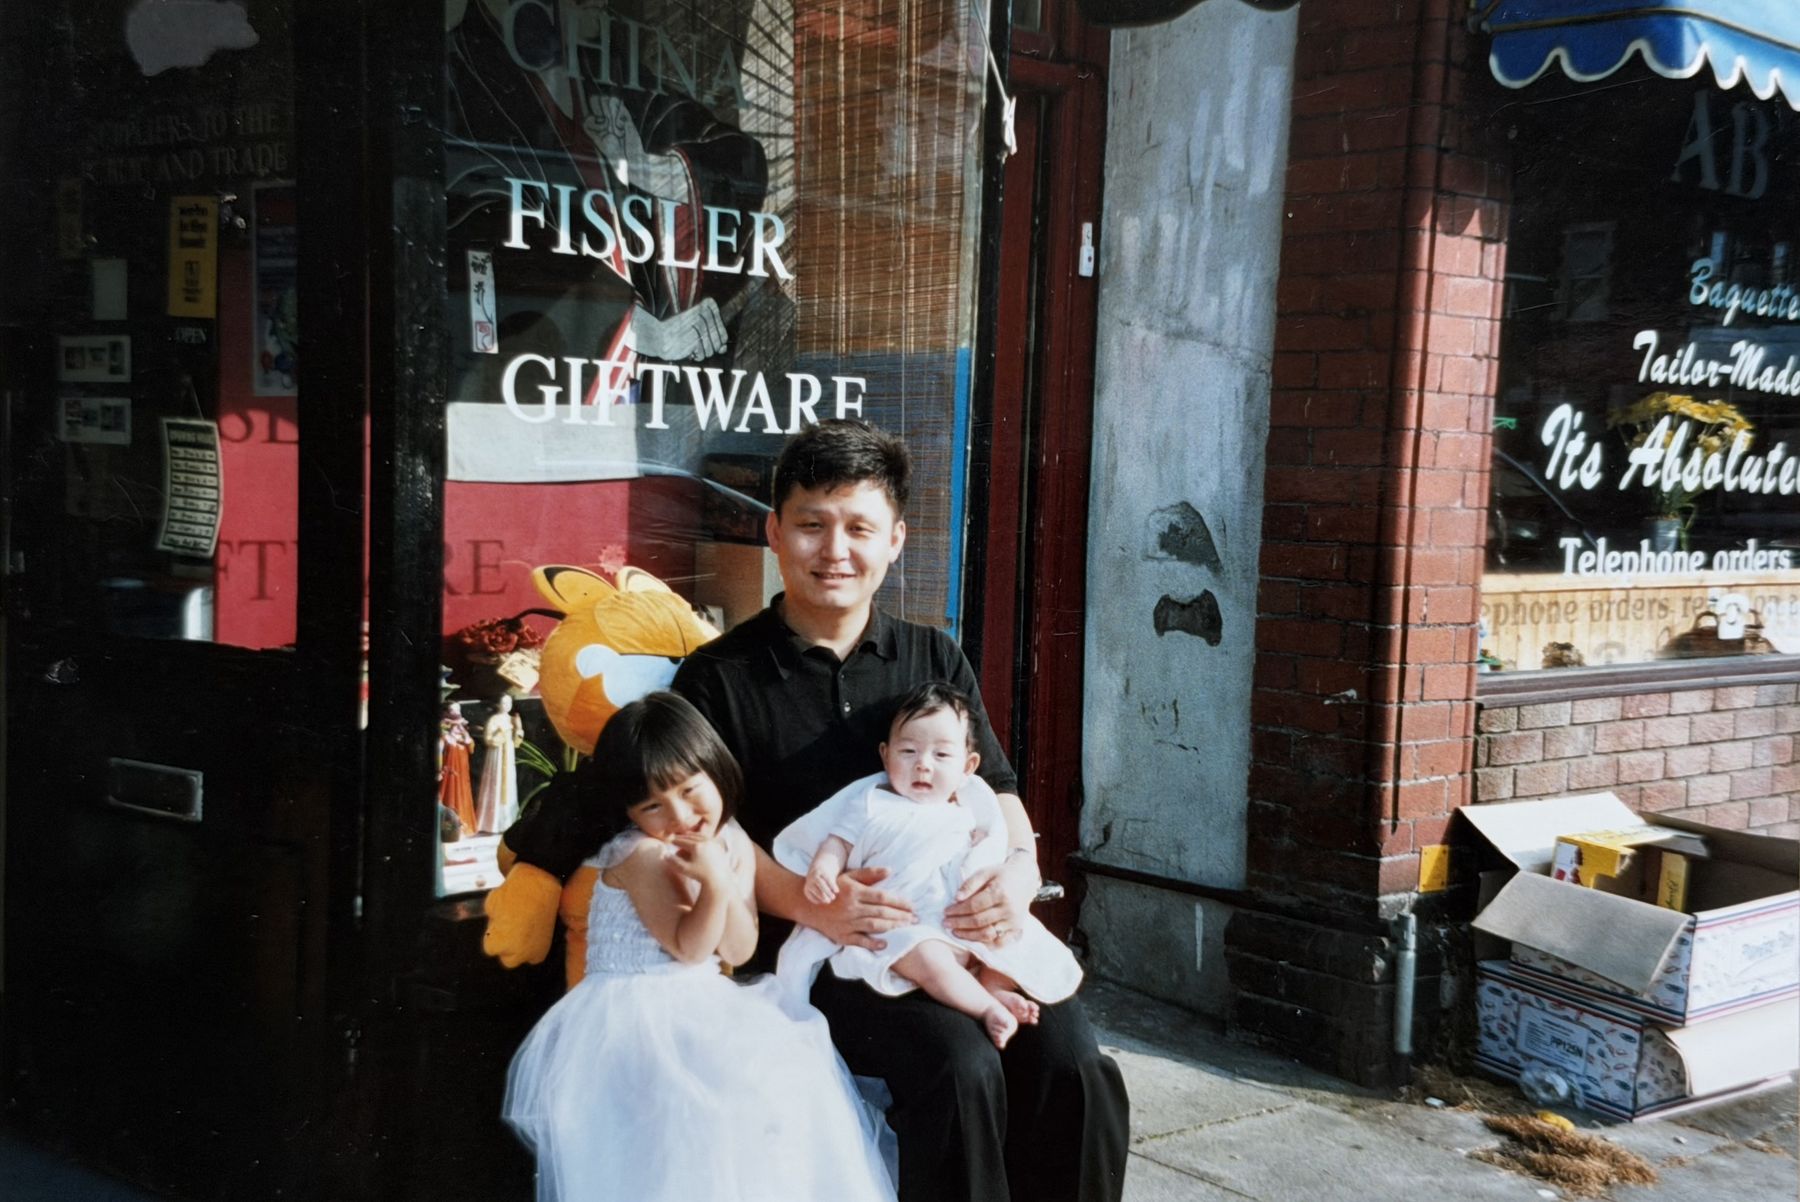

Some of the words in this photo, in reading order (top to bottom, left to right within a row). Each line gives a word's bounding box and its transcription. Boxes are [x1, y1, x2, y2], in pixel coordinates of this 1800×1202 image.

[502, 0, 749, 108] CHINA
[236, 102, 279, 135] THE
[157, 148, 205, 181] AND
[211, 142, 287, 177] TRADE
[503, 177, 793, 280] FISSLER
[502, 353, 867, 434] GIFTWARE
[1632, 329, 1800, 397] Tailor-Made
[1541, 403, 1603, 490] It's
[1618, 415, 1800, 495] Absolute
[1559, 537, 1705, 586] Telephone
[1713, 538, 1792, 572] orders
